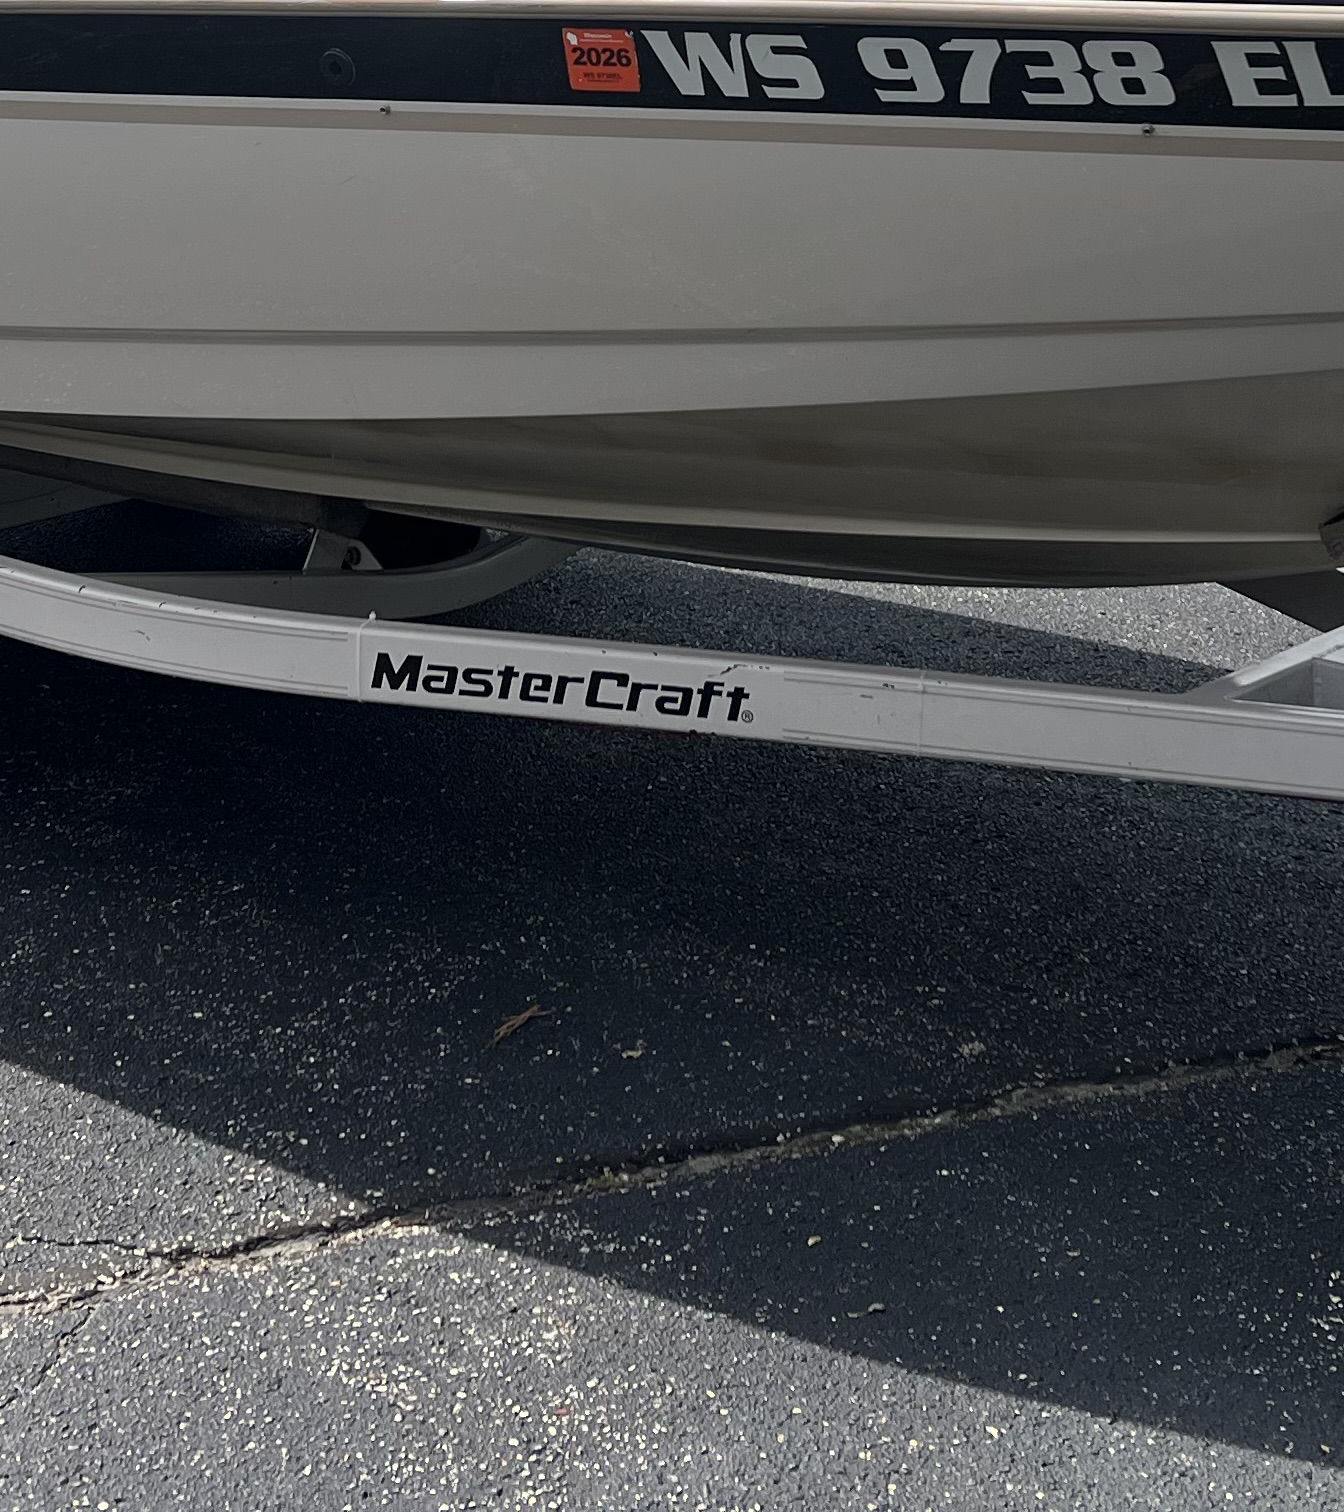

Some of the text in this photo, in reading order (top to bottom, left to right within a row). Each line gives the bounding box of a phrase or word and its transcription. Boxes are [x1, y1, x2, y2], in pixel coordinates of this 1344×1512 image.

[571, 46, 632, 67] 2026
[640, 29, 826, 100] WS
[856, 36, 1177, 106] 9738
[370, 651, 753, 723] MasterCraft
